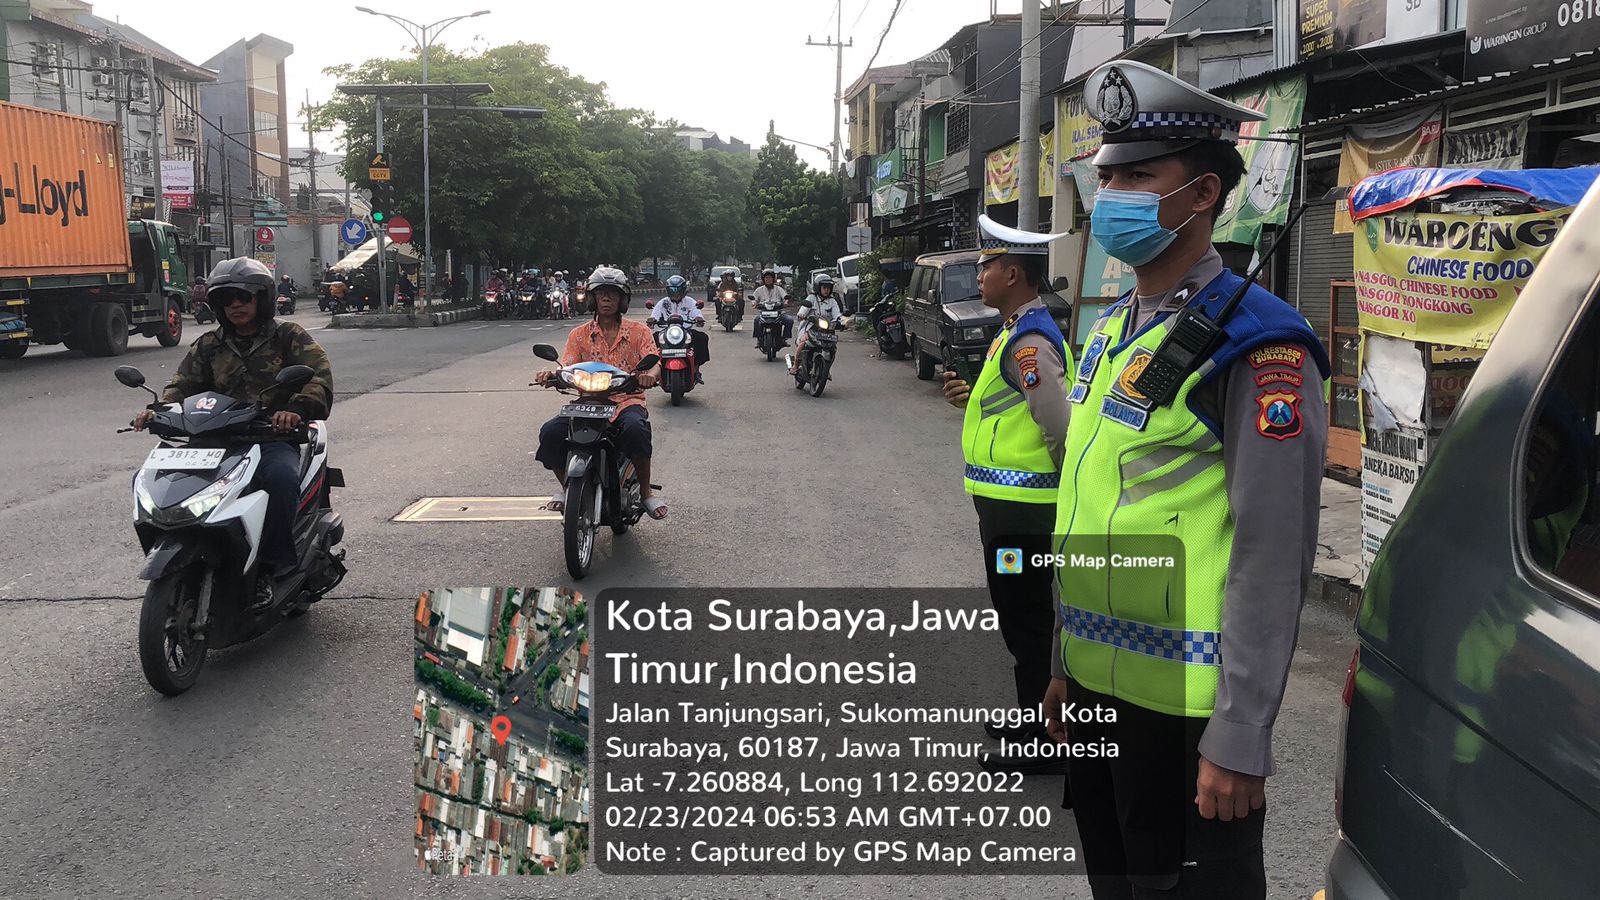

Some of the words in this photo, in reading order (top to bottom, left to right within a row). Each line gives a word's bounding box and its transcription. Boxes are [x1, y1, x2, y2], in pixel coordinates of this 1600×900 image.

[1305, 0, 1329, 18] SUPER
[1301, 11, 1333, 35] PREMIUM
[1483, 28, 1522, 49] WARINGIN
[1523, 21, 1548, 37] GROUP
[1421, 123, 1440, 136] BARU
[1383, 216, 1558, 252] WAROENG
[1407, 255, 1470, 280] CHINESE
[1472, 258, 1534, 282] FOOD
[1358, 287, 1404, 304] NASGOR
[1400, 278, 1449, 297] CHINESE
[1451, 285, 1498, 300] FOOD
[1358, 299, 1399, 321] NASGOR
[1402, 308, 1417, 324] XO
[1256, 354, 1297, 364] SURABAYA
[1260, 373, 1278, 383] JAWA
[1279, 373, 1299, 383] TIMUR
[150, 451, 156, 459] L
[168, 450, 198, 459] 3812
[1363, 455, 1388, 477] ANEKA
[1389, 463, 1415, 485] BAKSO
